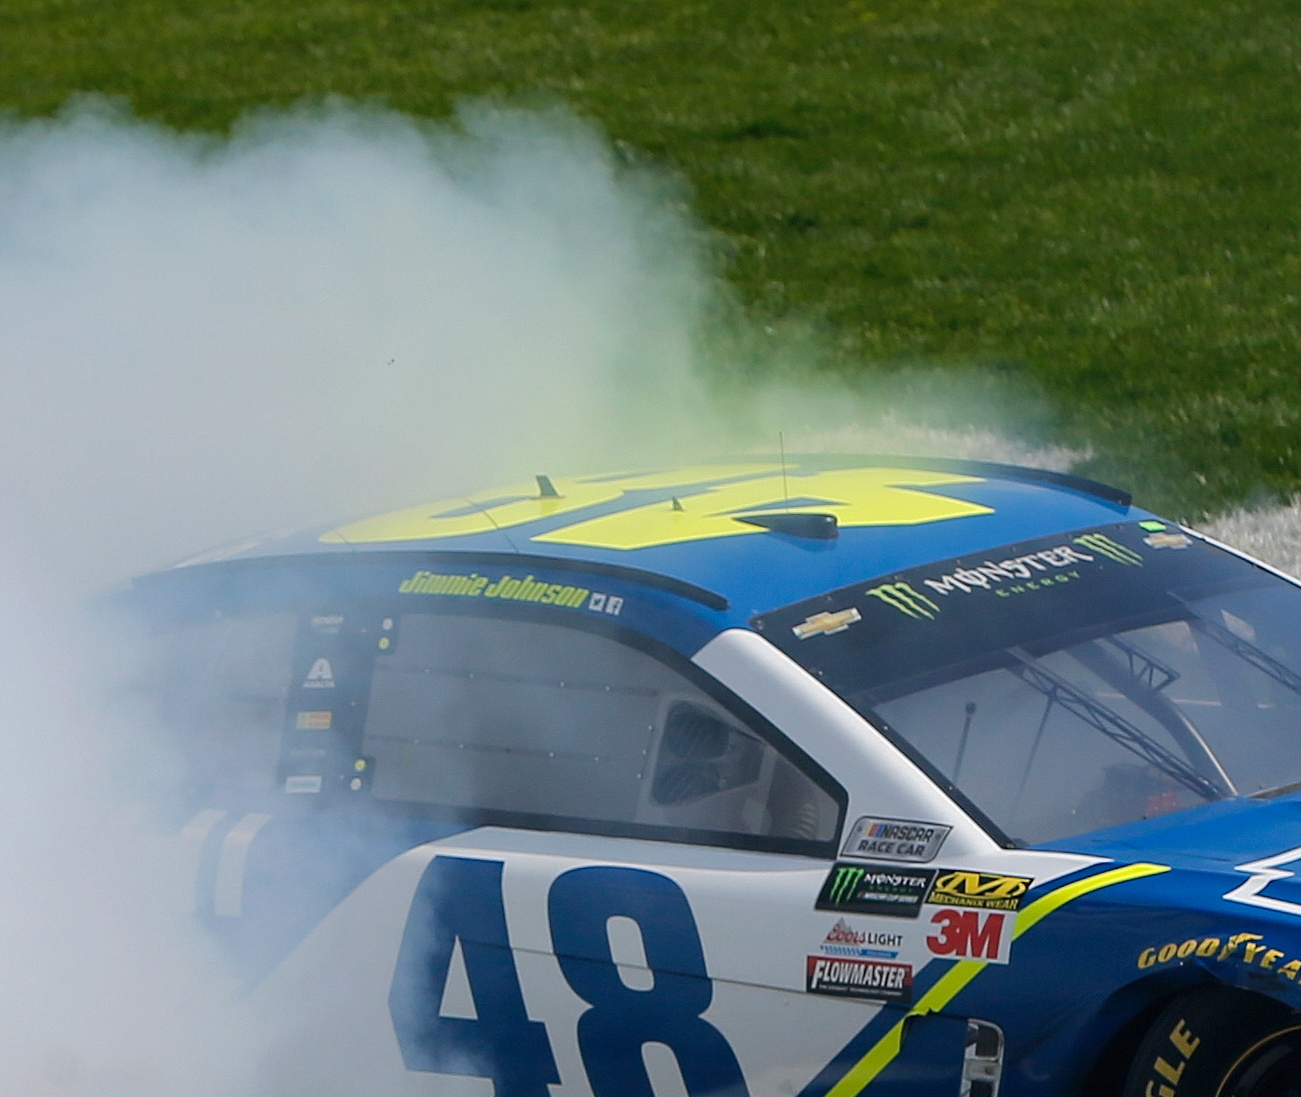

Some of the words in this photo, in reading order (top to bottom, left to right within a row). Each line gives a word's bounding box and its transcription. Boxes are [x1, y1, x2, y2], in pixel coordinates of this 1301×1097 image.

[924, 546, 1094, 596] MONSTER
[996, 570, 1080, 598] ENERGY
[399, 570, 489, 596] Jimmie
[485, 574, 590, 609] Johnson
[881, 824, 935, 844] NASCAR
[858, 839, 894, 853] RACE
[896, 844, 926, 857] CAR
[864, 872, 927, 889] MONSTER
[929, 891, 982, 908] MECHANIX
[984, 898, 1018, 911] WEAR
[826, 923, 867, 944] Coors
[868, 932, 904, 947] LIGHT
[926, 909, 1005, 960] 3M
[811, 960, 906, 990] FLOWMASTER
